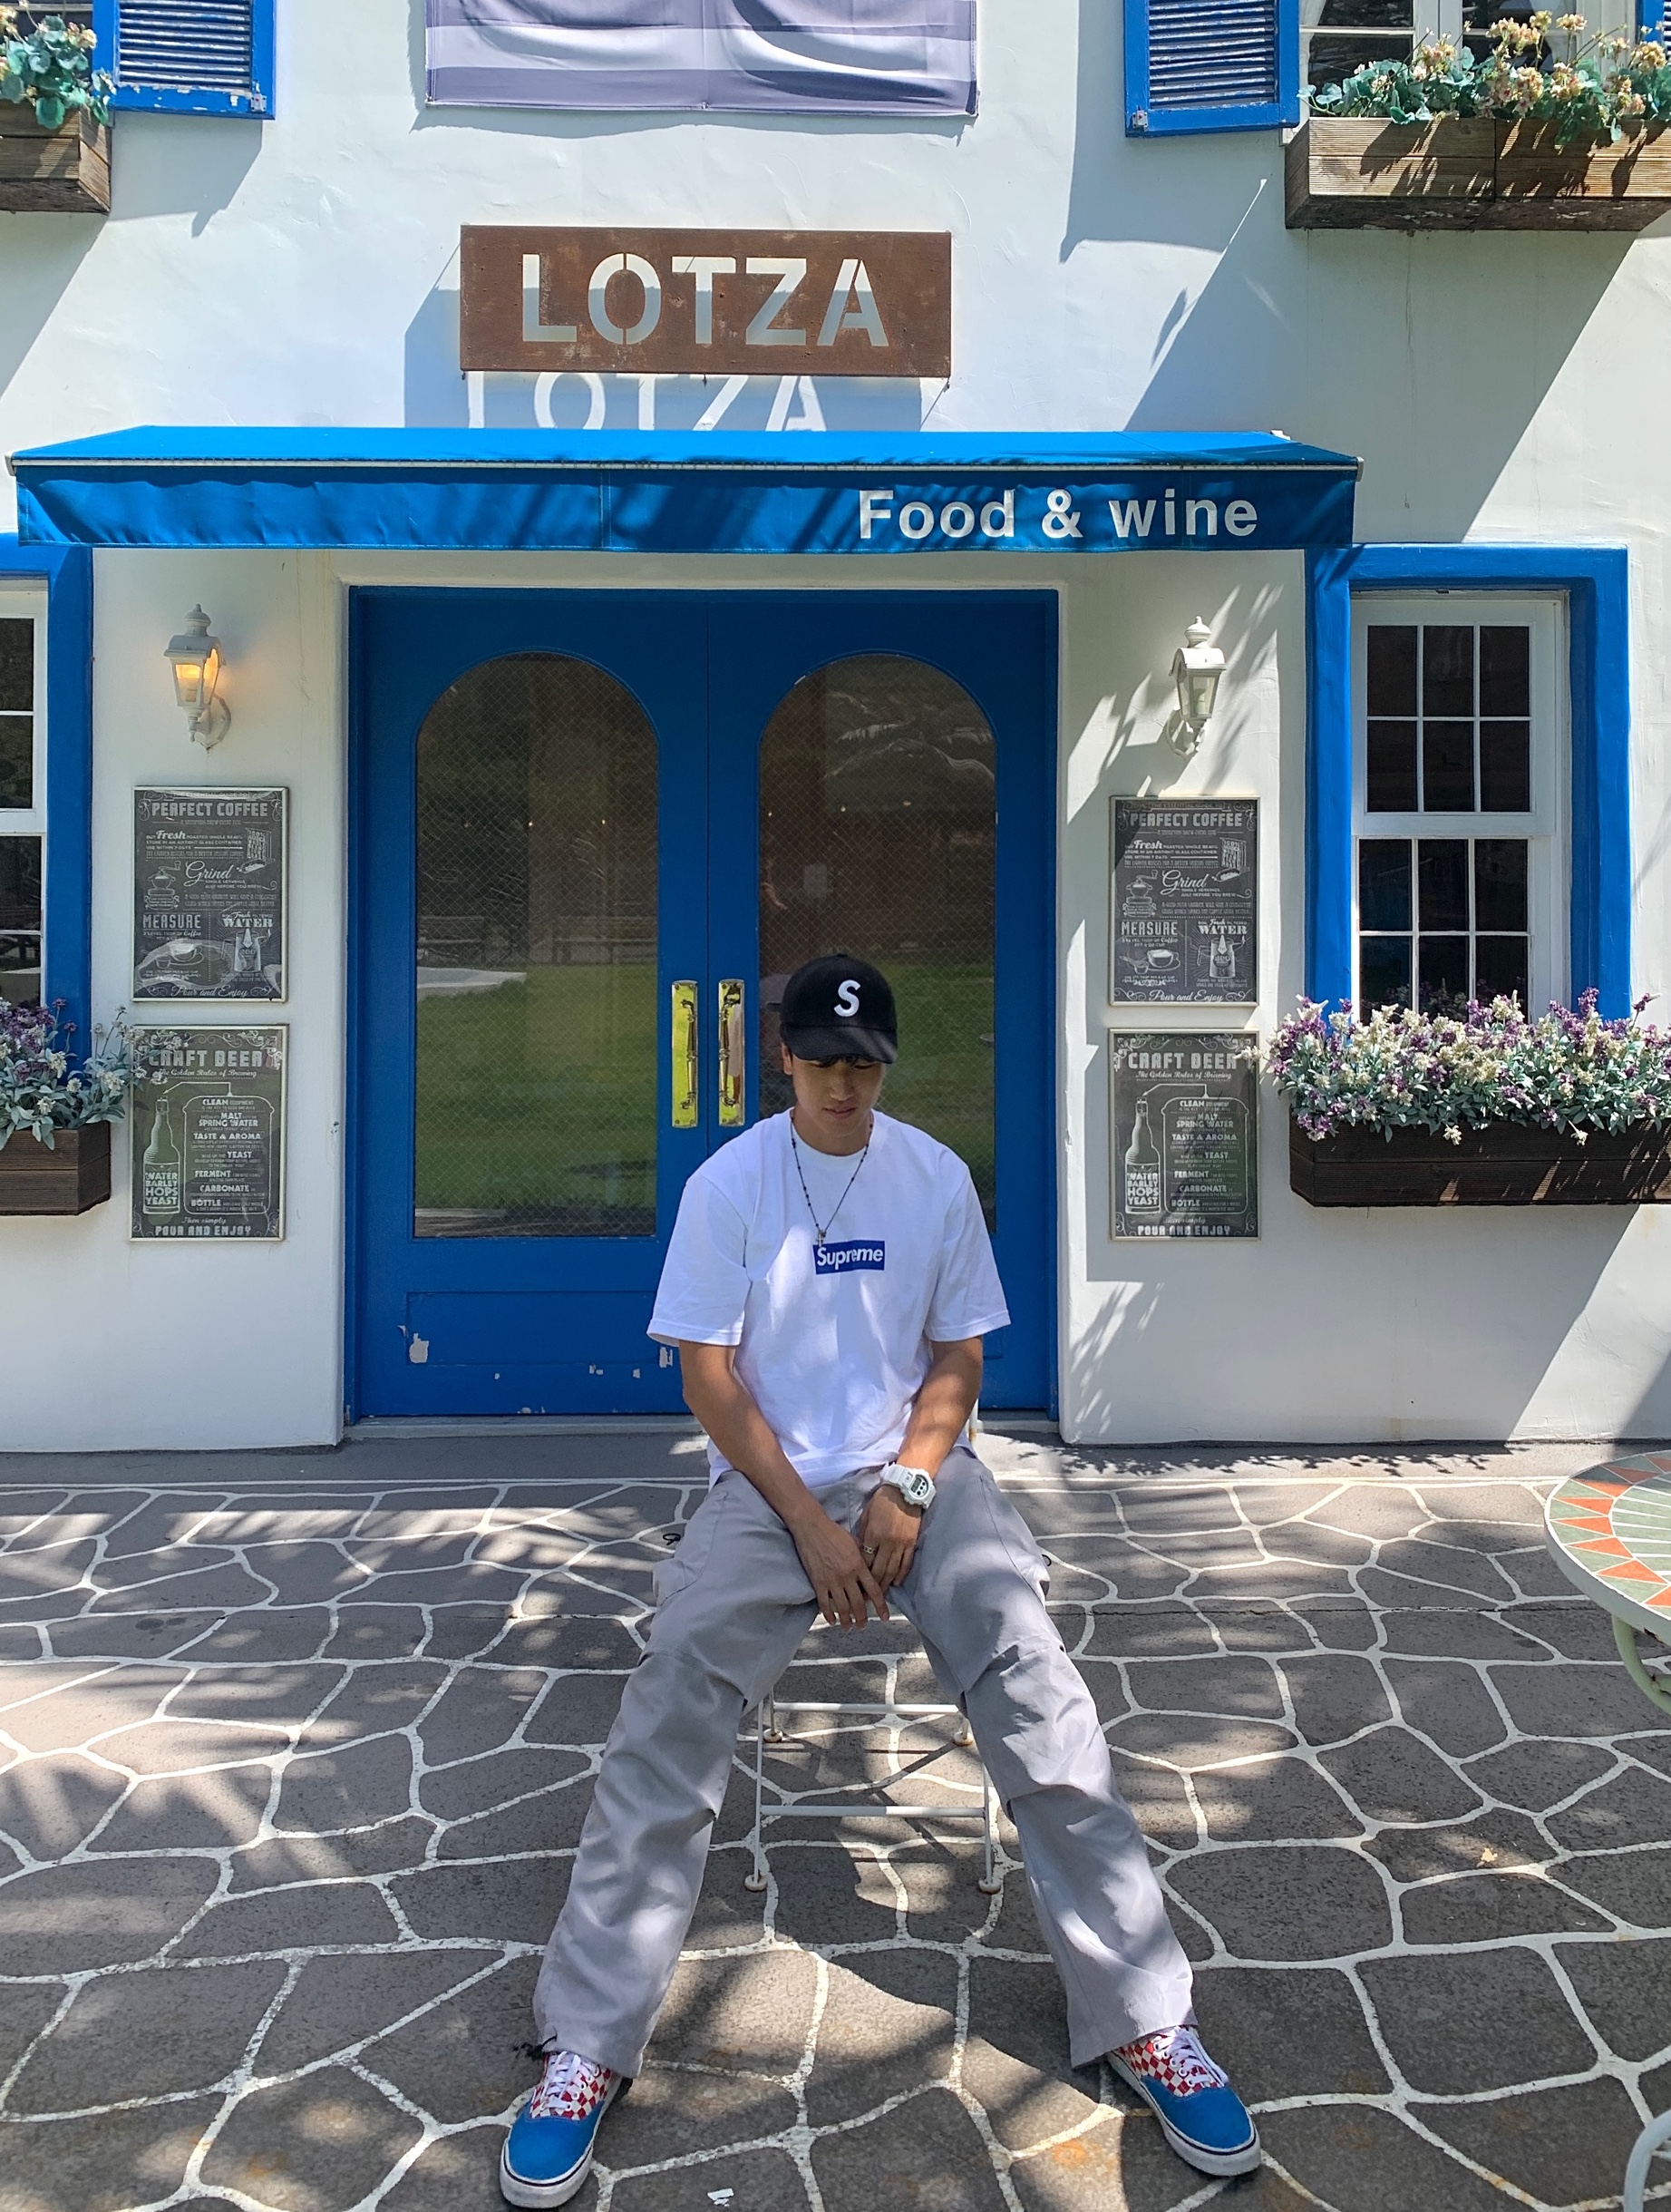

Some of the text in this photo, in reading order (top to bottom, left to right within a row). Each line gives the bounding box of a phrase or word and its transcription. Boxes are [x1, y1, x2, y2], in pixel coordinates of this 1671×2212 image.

[522, 252, 889, 347] LOTZA
[860, 488, 1258, 539] Food & wine
[152, 803, 268, 816] PERFECT COFFEE
[1130, 813, 1242, 827] PERFECT COFFEE
[155, 830, 186, 840] Fresh
[1133, 840, 1163, 850] Fresh
[183, 861, 234, 887] Grind
[1160, 869, 1210, 895] Grind
[142, 914, 201, 929] MEASURE
[222, 918, 273, 928] WATER
[1121, 921, 1178, 936] MEASURE
[1198, 925, 1248, 934] WATER
[170, 985, 248, 998] Pour and Enjoy
[833, 979, 861, 1017] S
[1148, 989, 1223, 1002] Pour and Enjoy
[214, 1050, 262, 1067] BEER
[1128, 1052, 1237, 1070] CRAFT BEER
[146, 1187, 178, 1196] HOPS
[1127, 1188, 1159, 1196] HOPS
[155, 1226, 251, 1235] POUR AND ENJOY
[1137, 1226, 1230, 1235] POUR AND ENJOY
[817, 1245, 884, 1269] Supreme
